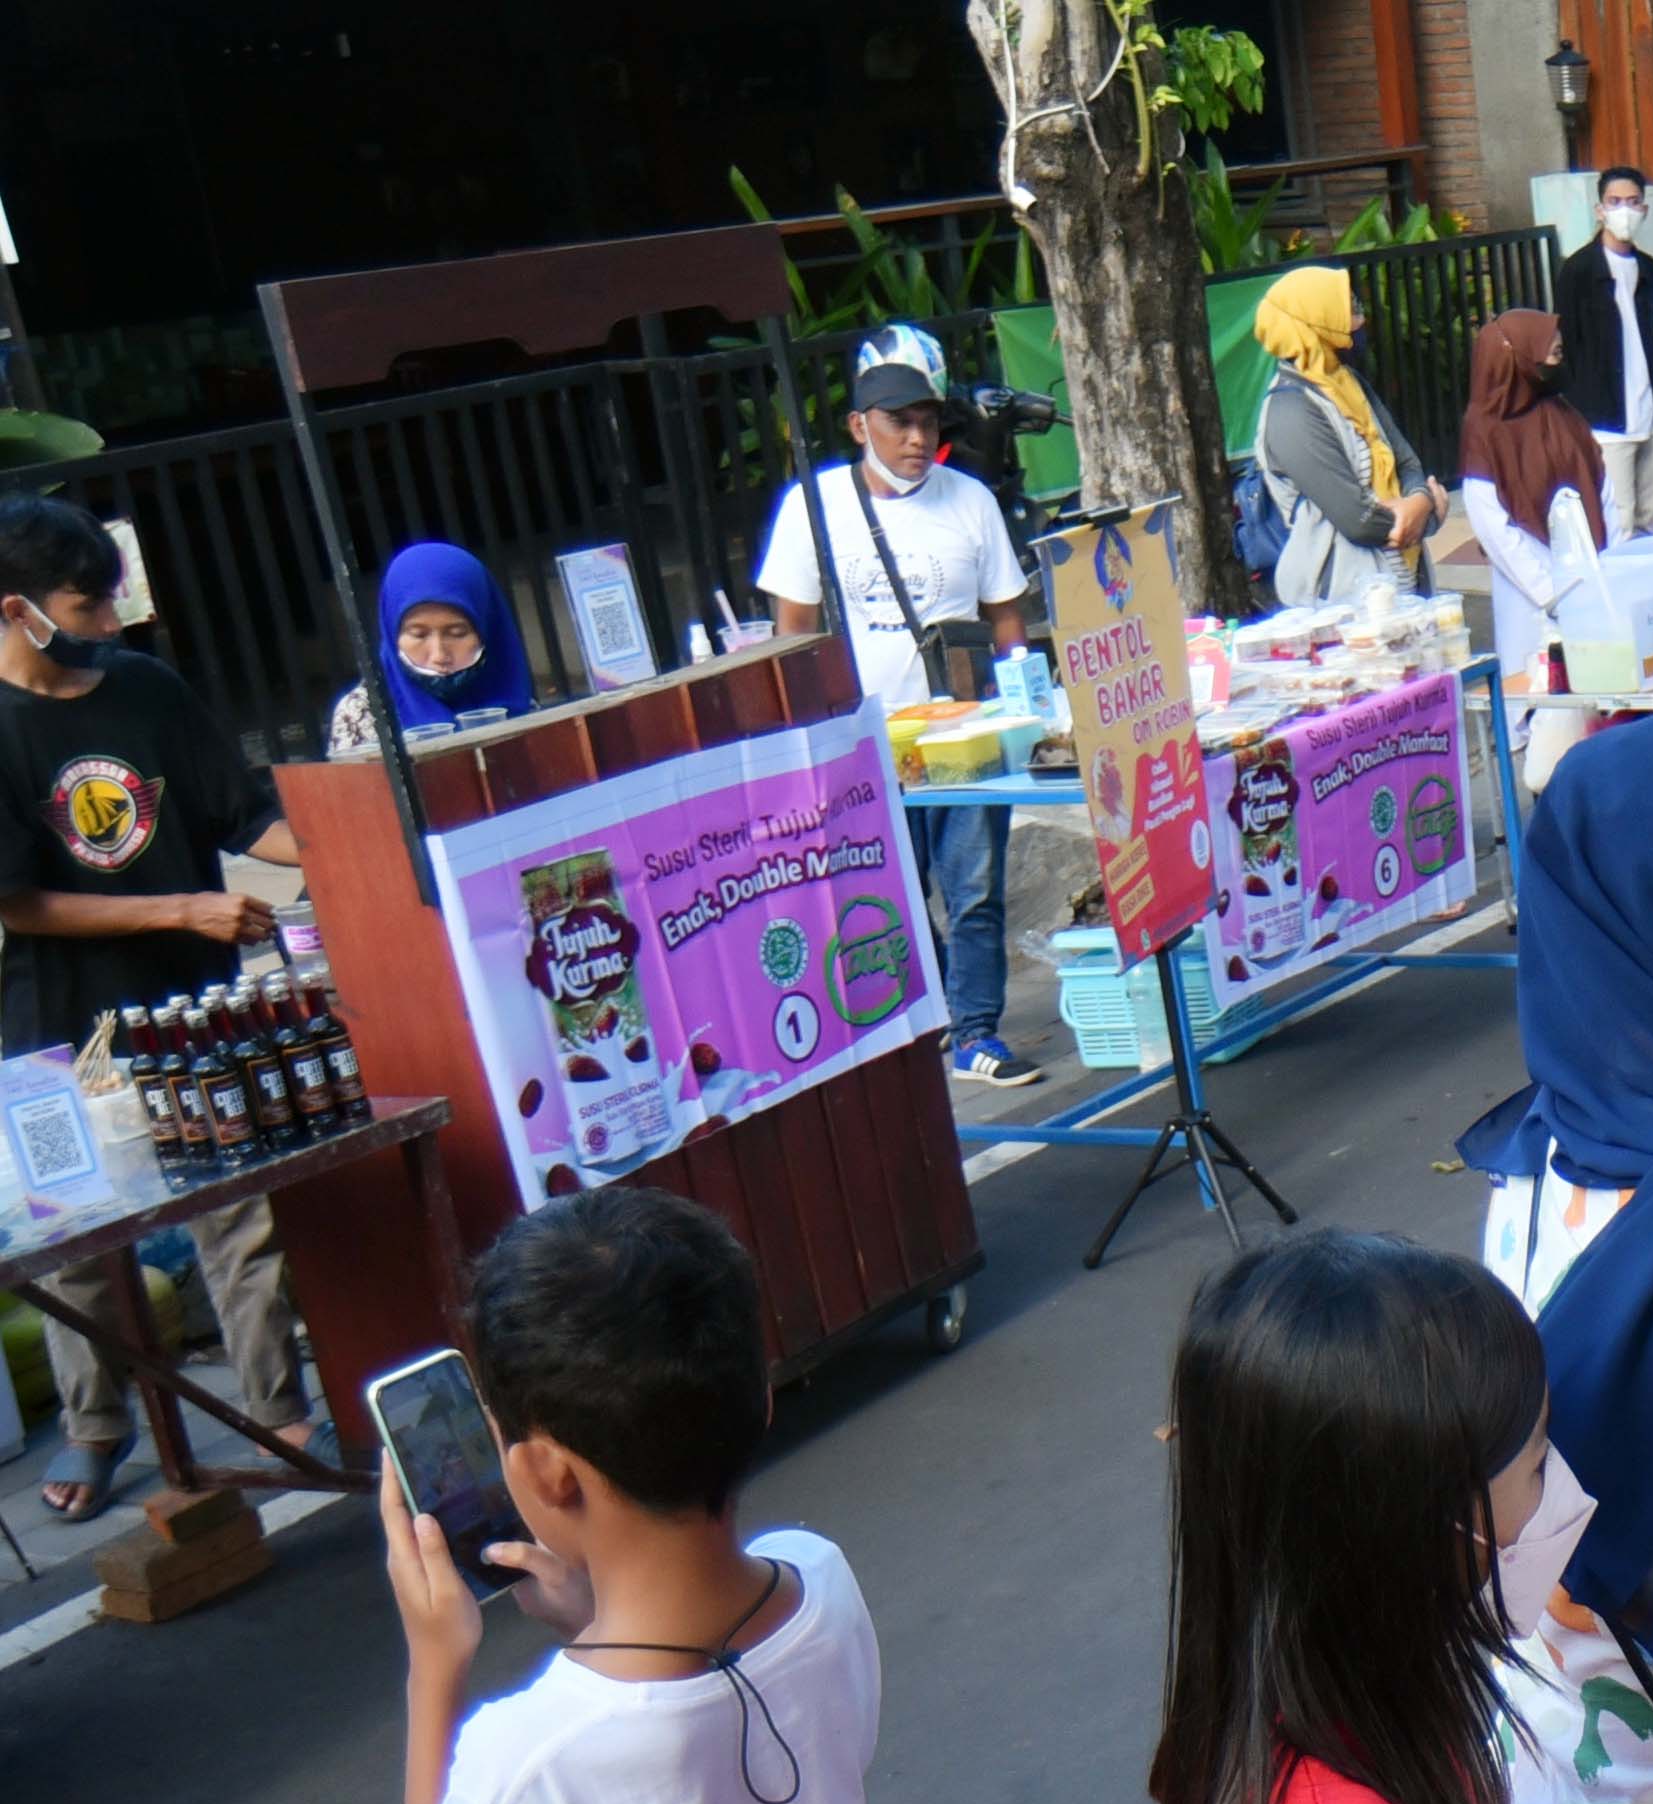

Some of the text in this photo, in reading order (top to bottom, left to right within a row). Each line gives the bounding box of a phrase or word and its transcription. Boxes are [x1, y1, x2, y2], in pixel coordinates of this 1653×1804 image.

[1066, 616, 1152, 685] PENTOL
[1097, 664, 1165, 725] BAKAR
[1306, 726, 1342, 750] Susu
[1342, 709, 1380, 738] Steril
[1241, 771, 1289, 804] Tujuh
[1312, 758, 1353, 801] Enak,
[1352, 738, 1399, 775] Double
[644, 847, 697, 882] Susu
[1381, 858, 1392, 883] 6
[661, 893, 723, 948] Enak,
[720, 858, 803, 907] Double
[540, 914, 621, 960] Tujuh
[548, 951, 628, 1001] Kurma
[786, 1010, 802, 1044] 1
